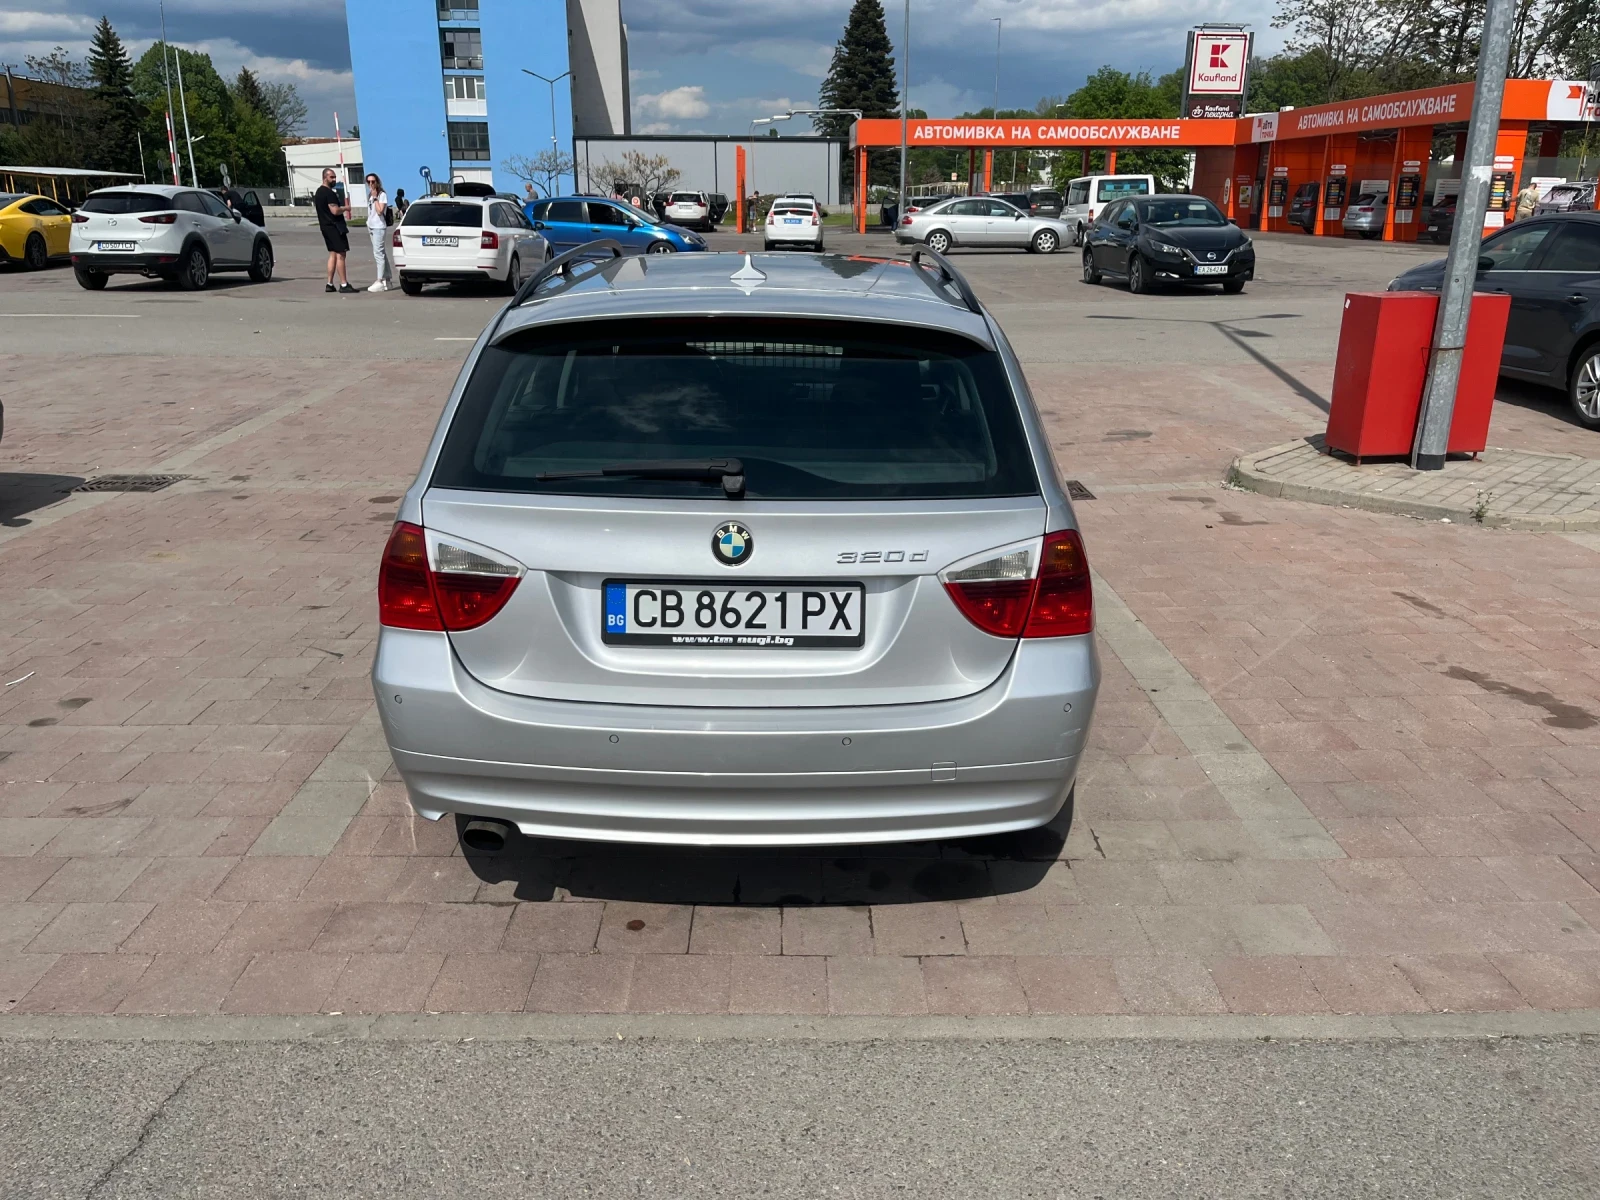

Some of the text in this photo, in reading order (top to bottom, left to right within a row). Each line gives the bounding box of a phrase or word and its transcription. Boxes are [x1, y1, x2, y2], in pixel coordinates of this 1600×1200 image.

[1198, 73, 1237, 82] Kaufland
[1297, 94, 1457, 130] АВТОМИВКА НА САМООБСЛУЖВАНЕ
[914, 125, 1181, 139] АВТОМИВКА НА САМООБСЛУЖВАНЕ
[836, 549, 930, 564] 320d
[633, 589, 853, 630] CB 8621 PX
[607, 614, 625, 626] BG
